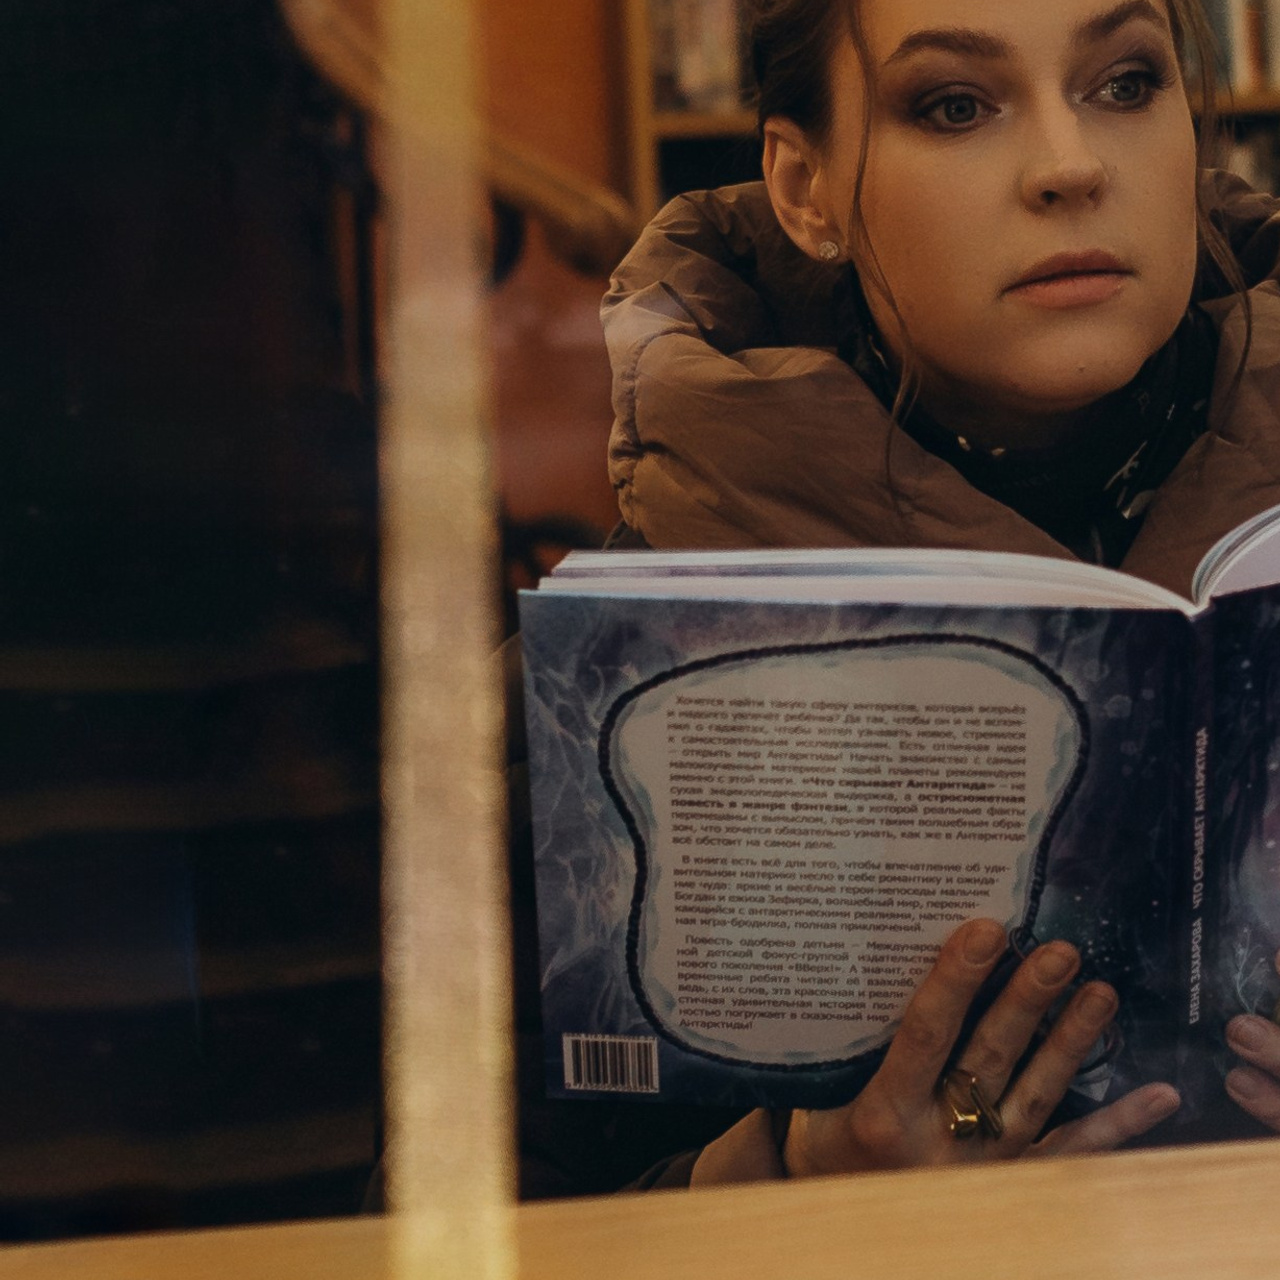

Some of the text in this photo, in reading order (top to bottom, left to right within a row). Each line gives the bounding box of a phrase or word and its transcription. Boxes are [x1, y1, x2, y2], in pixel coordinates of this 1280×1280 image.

[1189, 726, 1209, 1025] ЕЛЕНА ЗАХАРОВА ЧТО СКРЫВАЕТ АНТАРКТИДА
[674, 915, 925, 935] ная игра-бродилка, полная приключений.
[675, 945, 699, 956] ной
[705, 946, 754, 960] детской
[760, 948, 850, 963] фокус-группой
[677, 996, 899, 1012] стичная удивительная история пол-
[678, 1008, 722, 1017] ностью
[724, 1009, 786, 1021] погружает
[866, 1013, 890, 1024] мир
